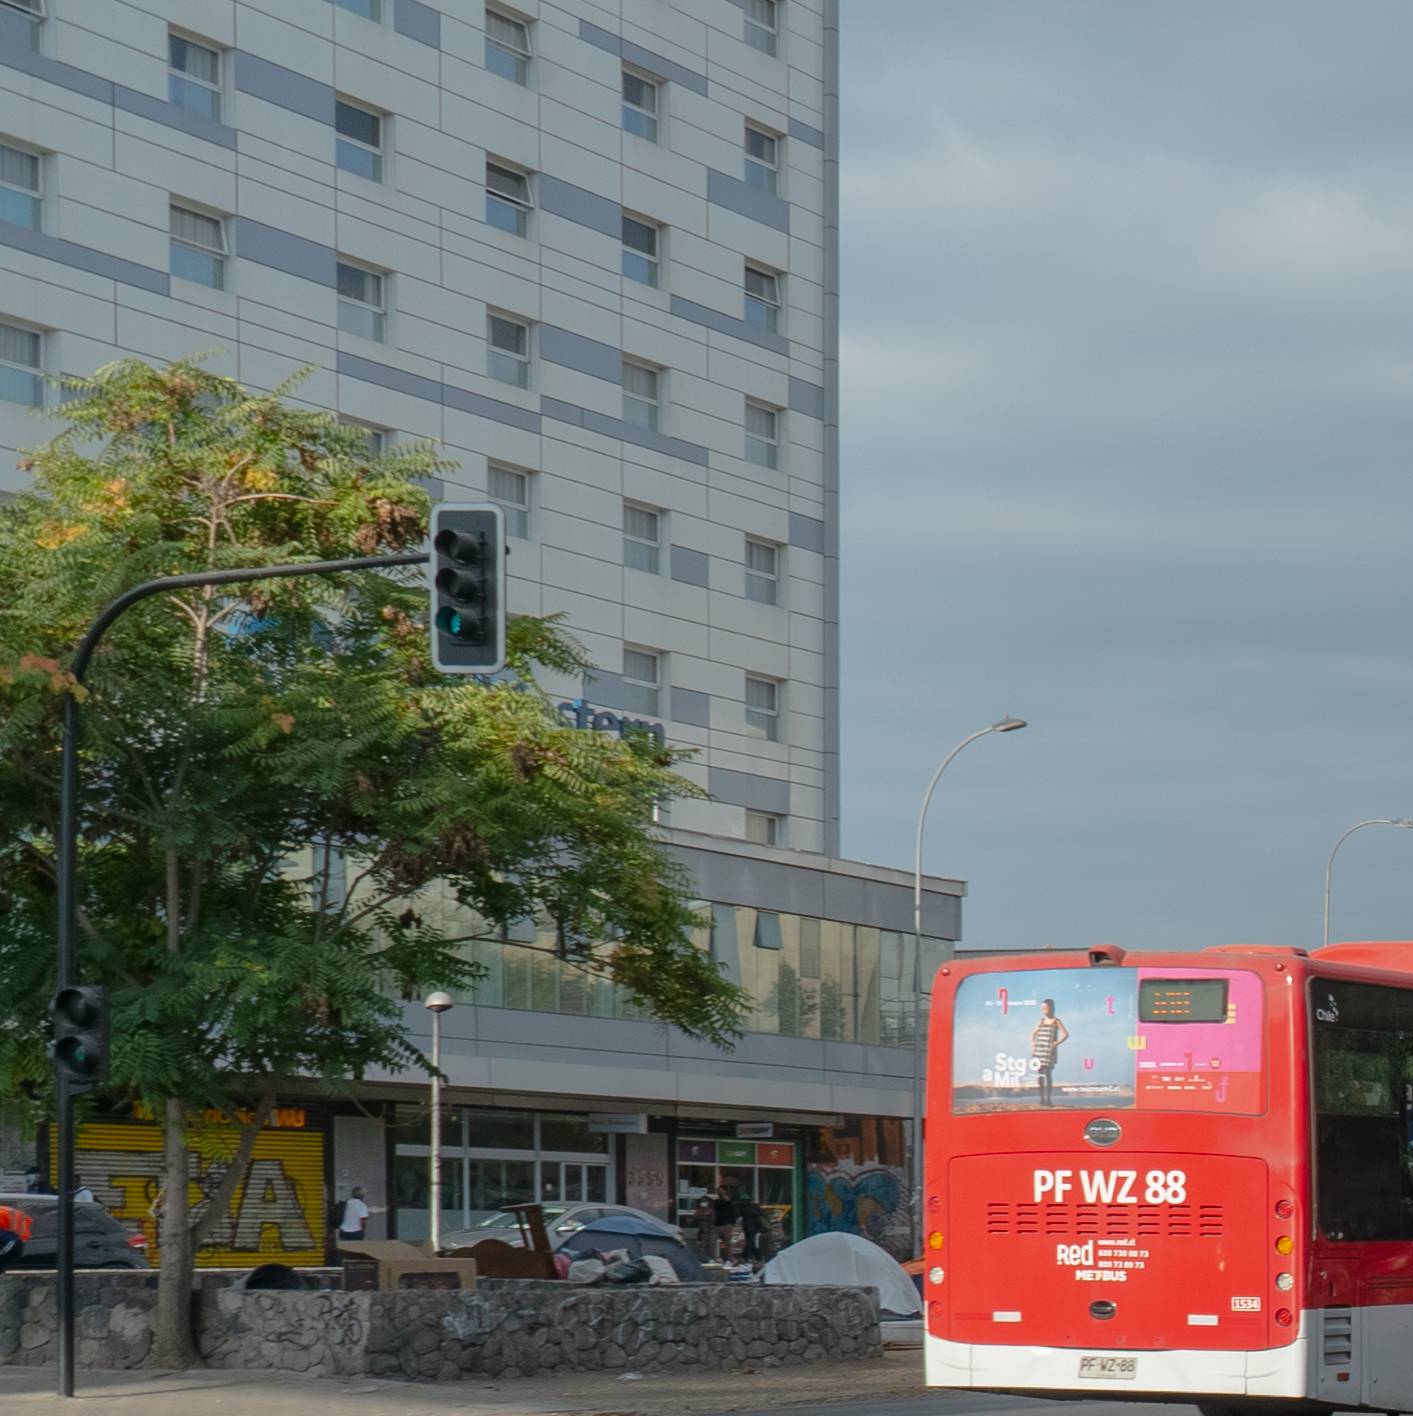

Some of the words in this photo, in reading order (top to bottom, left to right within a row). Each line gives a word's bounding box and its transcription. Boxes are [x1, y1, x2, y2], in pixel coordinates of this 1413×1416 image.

[1034, 1170, 1072, 1203] PF
[1079, 1170, 1137, 1204] WZ
[1145, 1170, 1186, 1204] 88
[1057, 1240, 1094, 1266] Red
[1233, 1299, 1259, 1309] 1534
